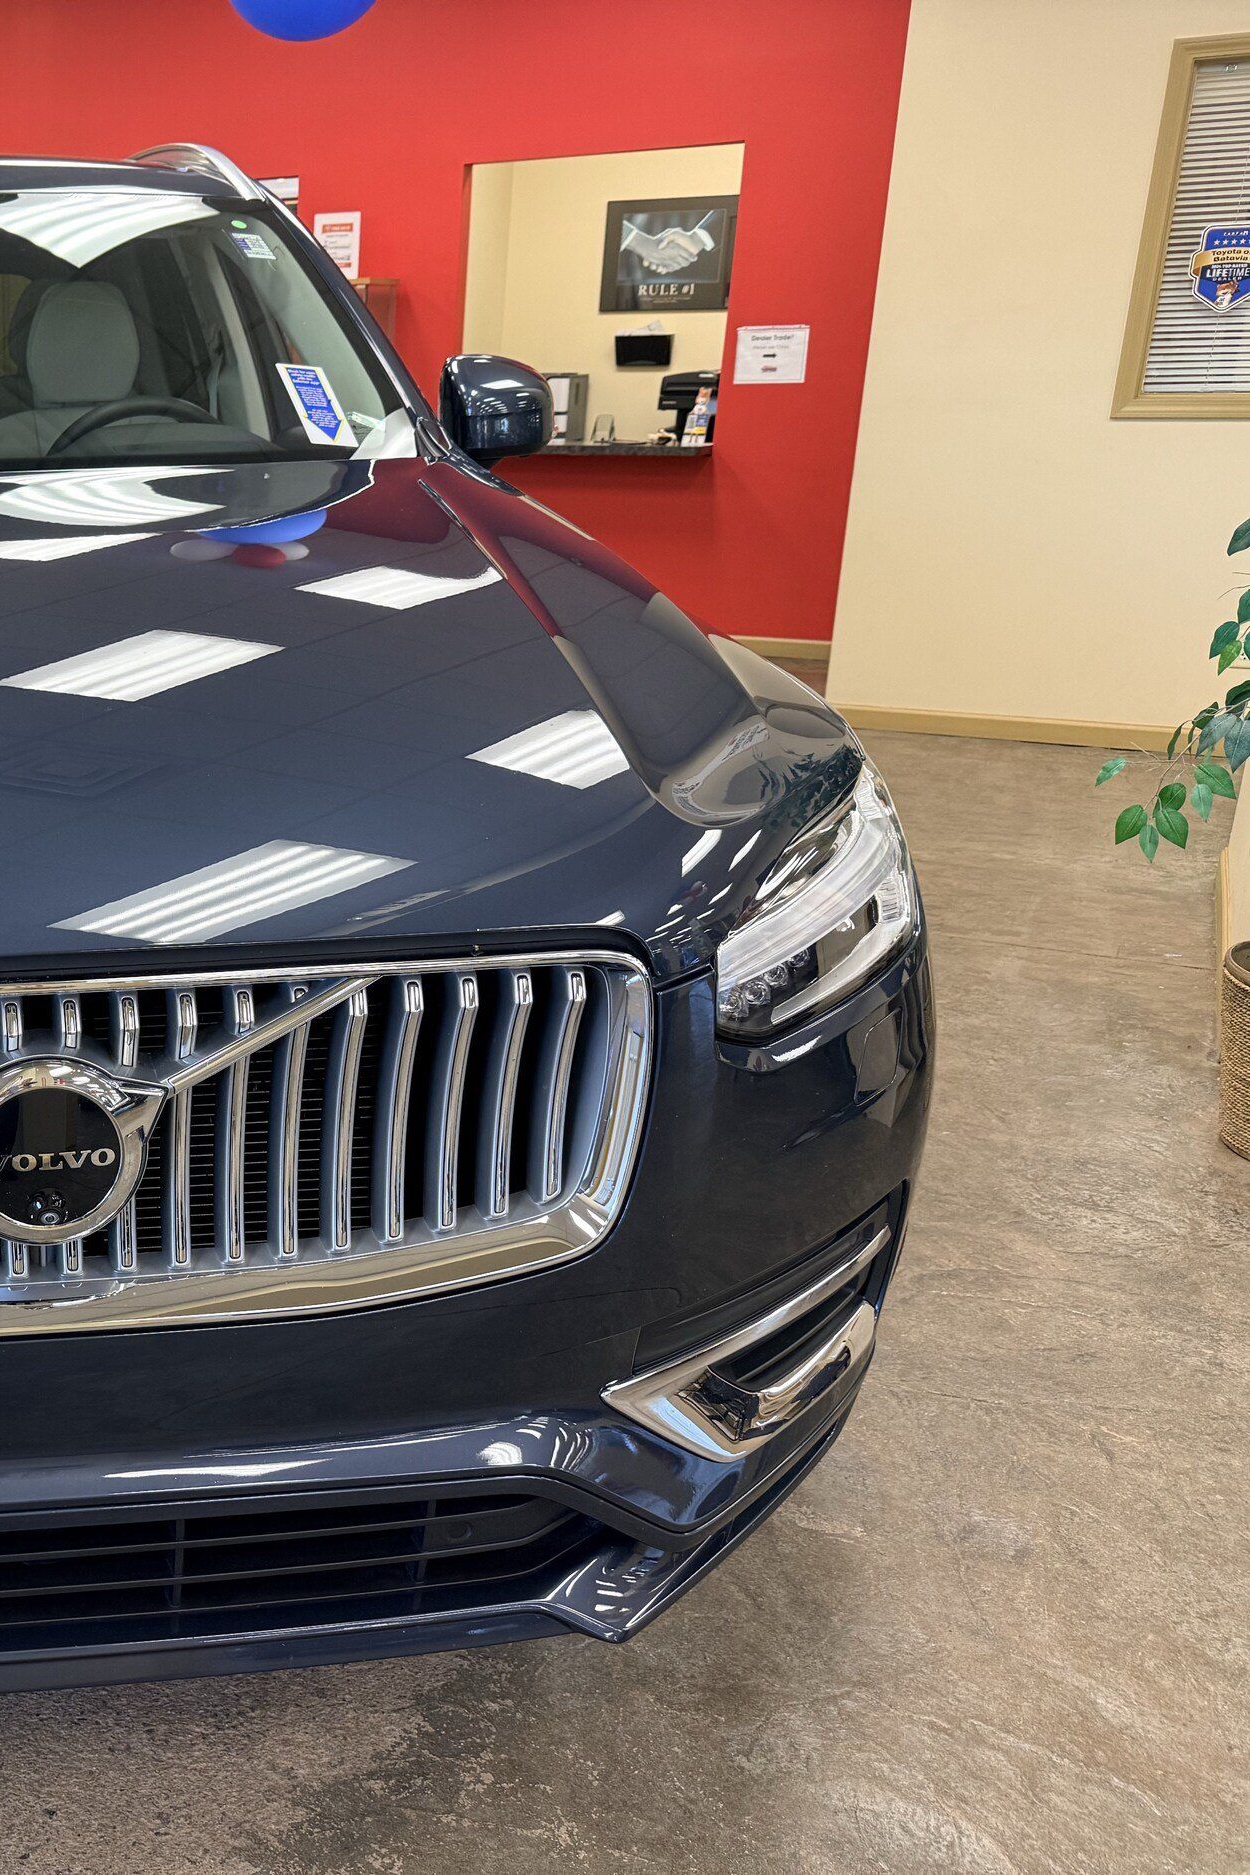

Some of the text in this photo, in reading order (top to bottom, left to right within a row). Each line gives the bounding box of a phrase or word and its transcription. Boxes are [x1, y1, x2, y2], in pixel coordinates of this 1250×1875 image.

[1206, 268, 1250, 278] LIFETIME
[638, 283, 695, 296] RULE #1
